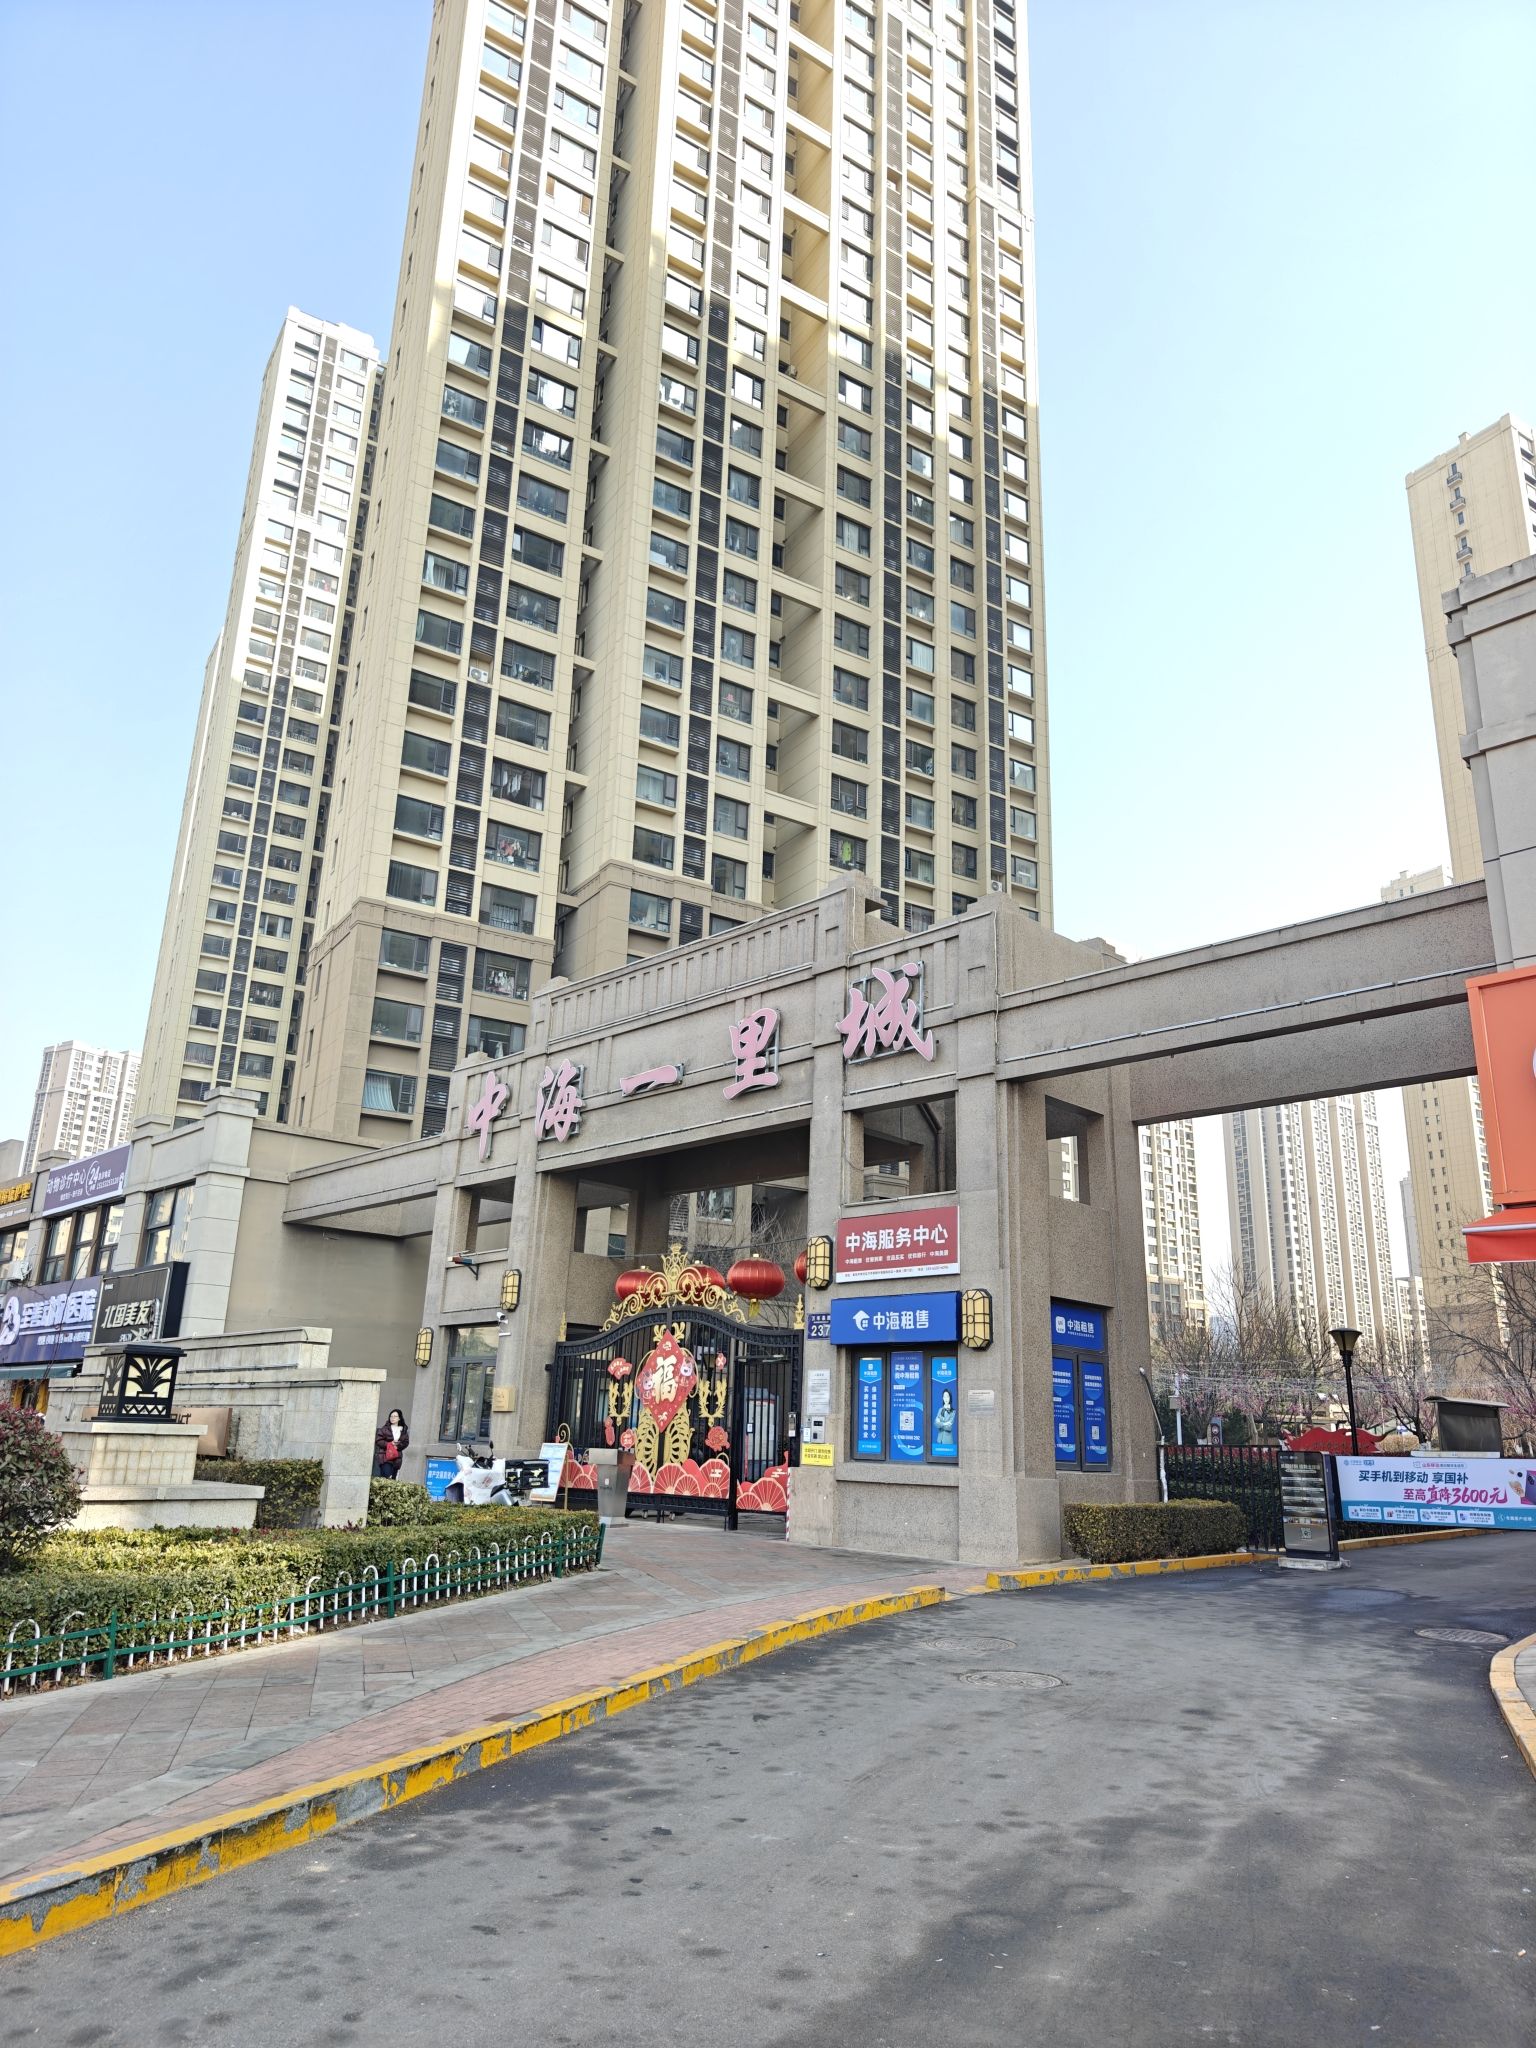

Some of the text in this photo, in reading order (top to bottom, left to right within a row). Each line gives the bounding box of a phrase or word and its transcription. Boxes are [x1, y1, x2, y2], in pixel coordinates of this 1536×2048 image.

[467, 962, 937, 1162] 中海一里城
[845, 1223, 949, 1253] 中海服务中心
[101, 1300, 153, 1329] 北国美发
[873, 1309, 929, 1331] 中海租售
[811, 1324, 831, 1337] 237
[1067, 1318, 1095, 1334] 中海租售
[652, 1355, 678, 1404] 福
[1358, 1470, 1469, 1485] 买手机到移动 享国补
[1403, 1485, 1508, 1506] 至高直降3600元
